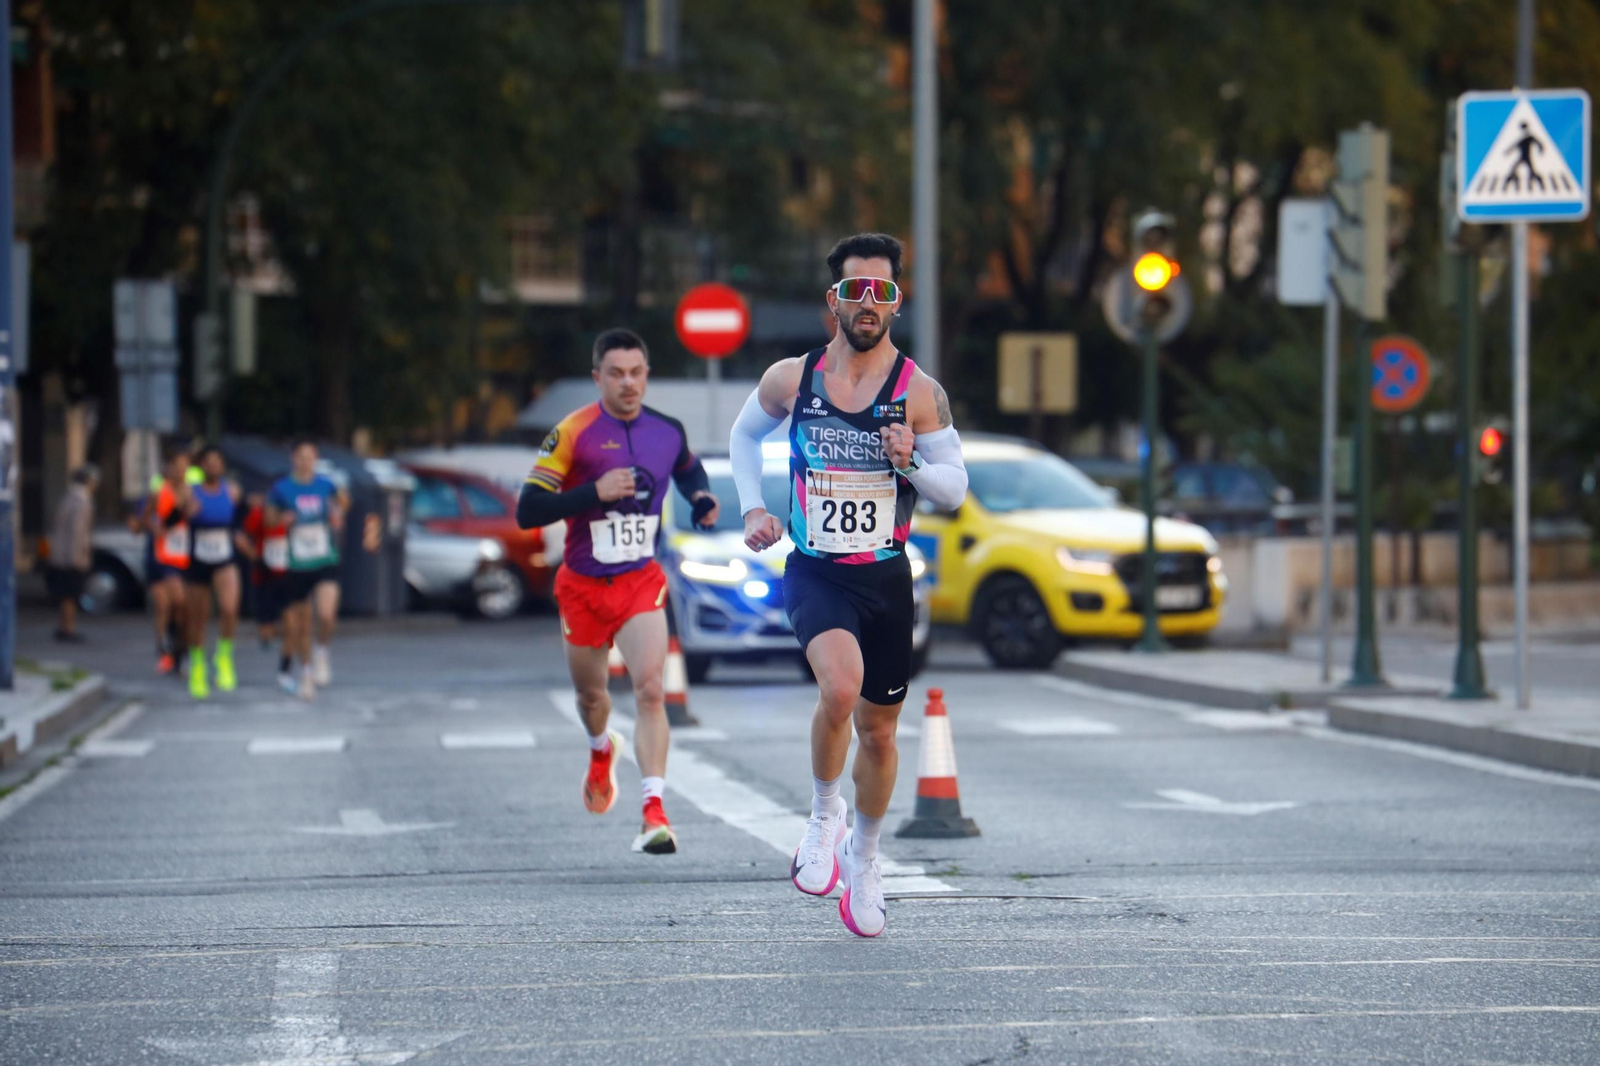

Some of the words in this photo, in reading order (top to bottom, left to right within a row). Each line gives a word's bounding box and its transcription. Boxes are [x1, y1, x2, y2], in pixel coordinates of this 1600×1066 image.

[802, 407, 828, 416] VIATOR
[809, 473, 832, 497] XLI
[822, 499, 877, 534] 283
[607, 519, 646, 547] 155
